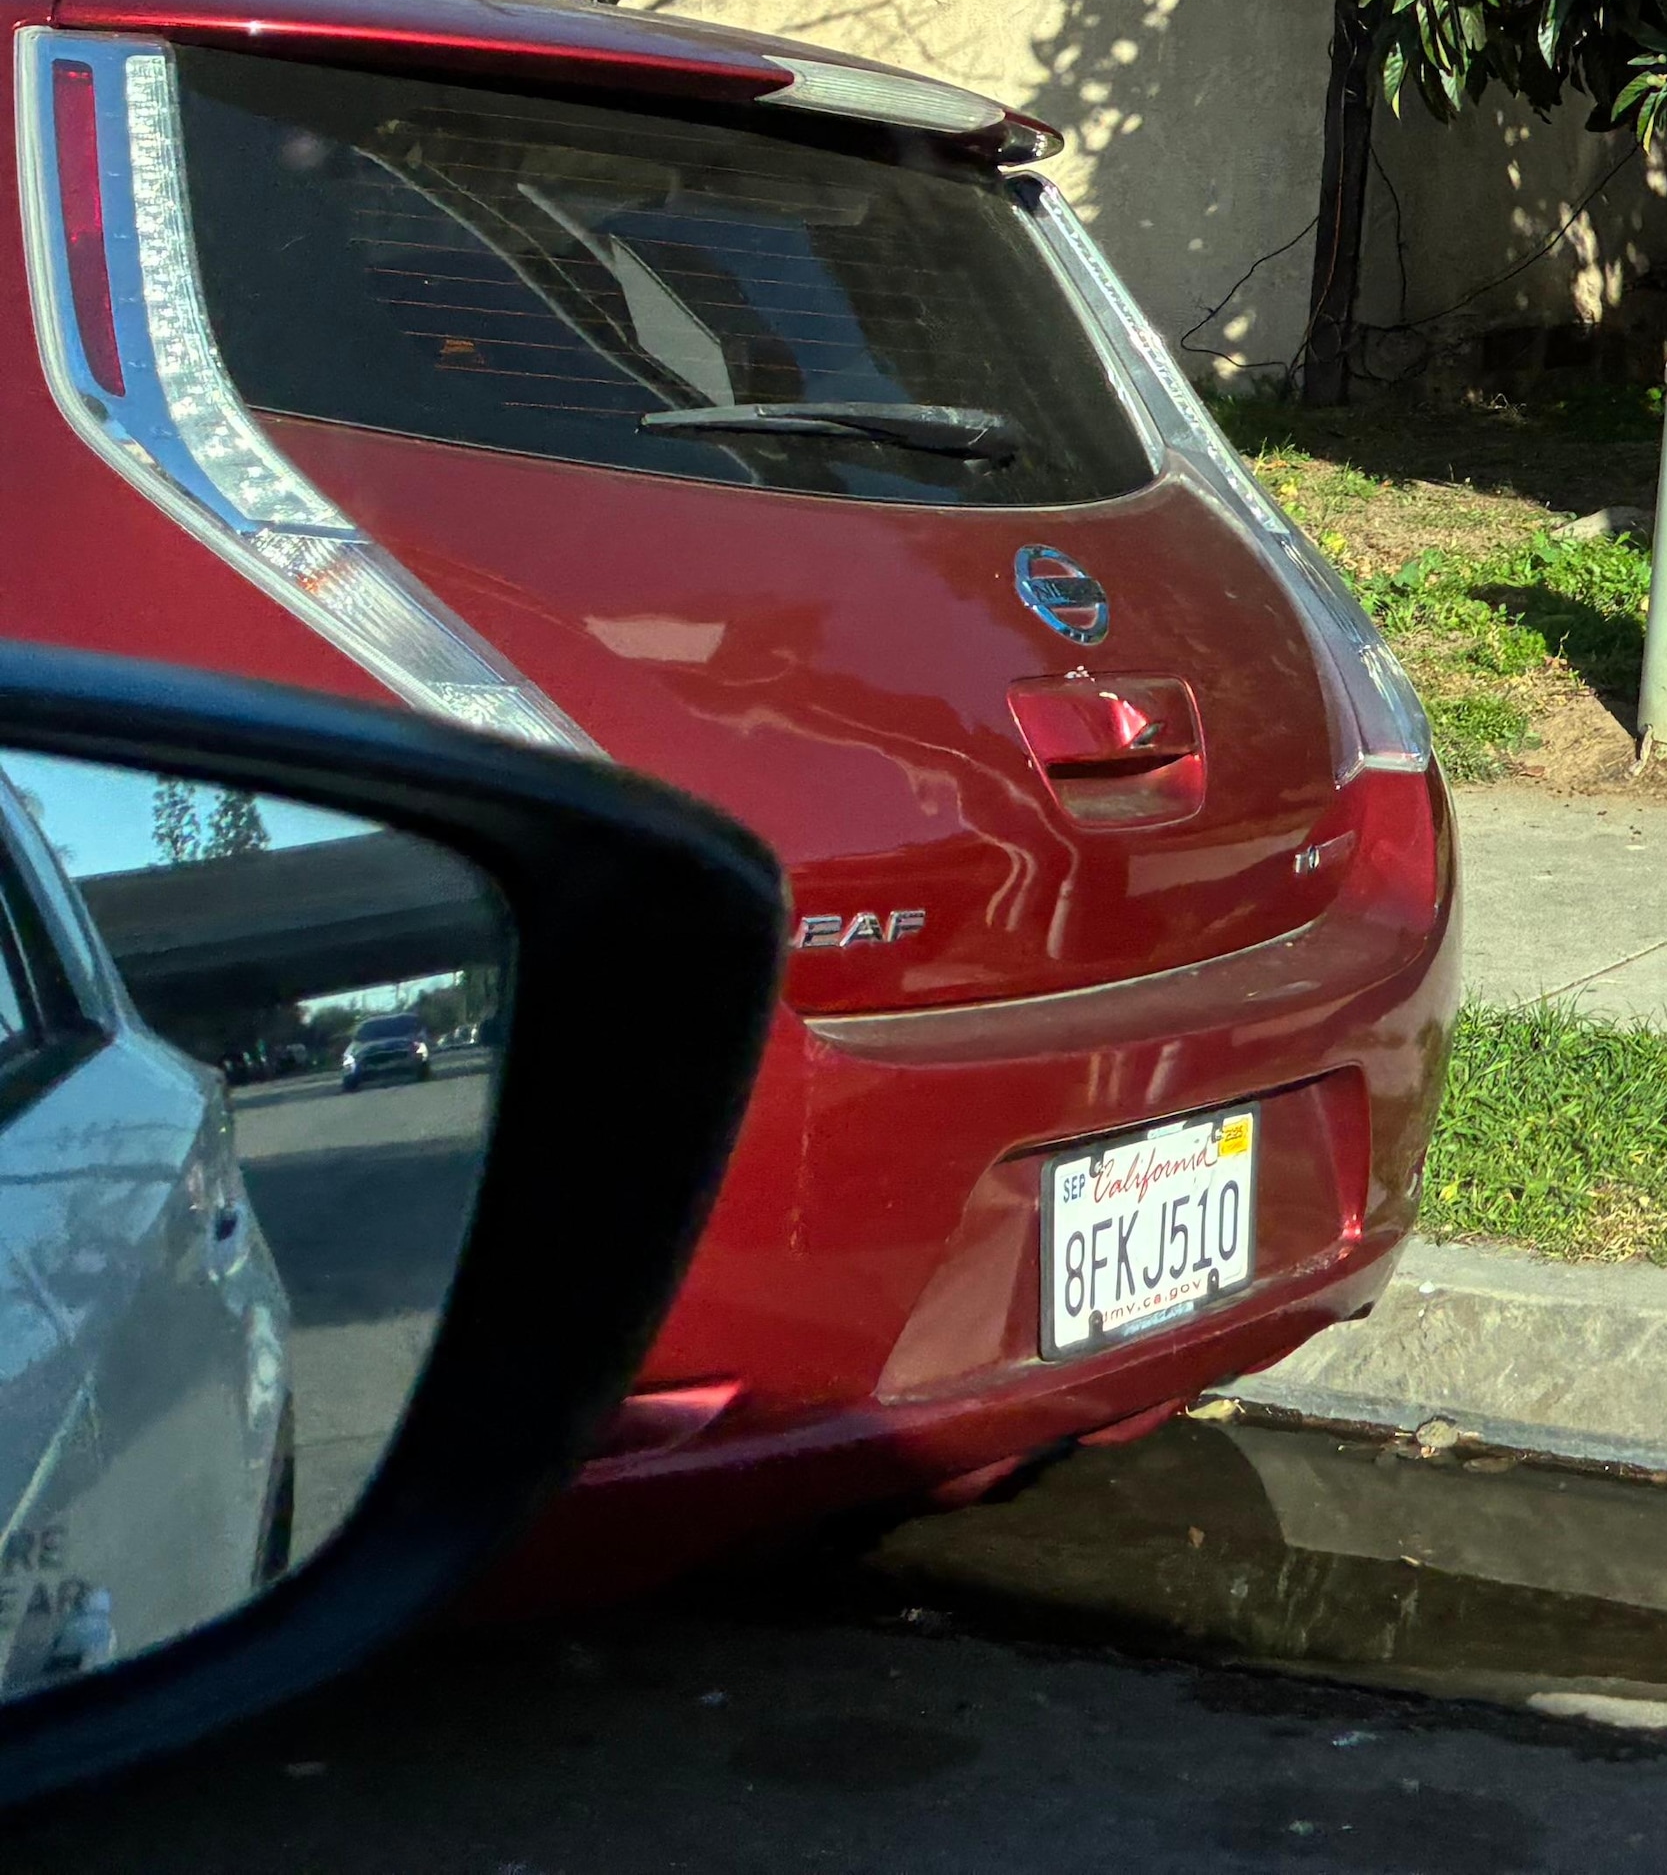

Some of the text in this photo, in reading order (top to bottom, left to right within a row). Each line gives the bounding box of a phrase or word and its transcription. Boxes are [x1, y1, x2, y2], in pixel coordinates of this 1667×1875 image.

[796, 910, 926, 948] EAF
[1063, 1173, 1086, 1203] SEP
[1093, 1144, 1218, 1204] California
[1064, 1180, 1240, 1318] 8FKJ510
